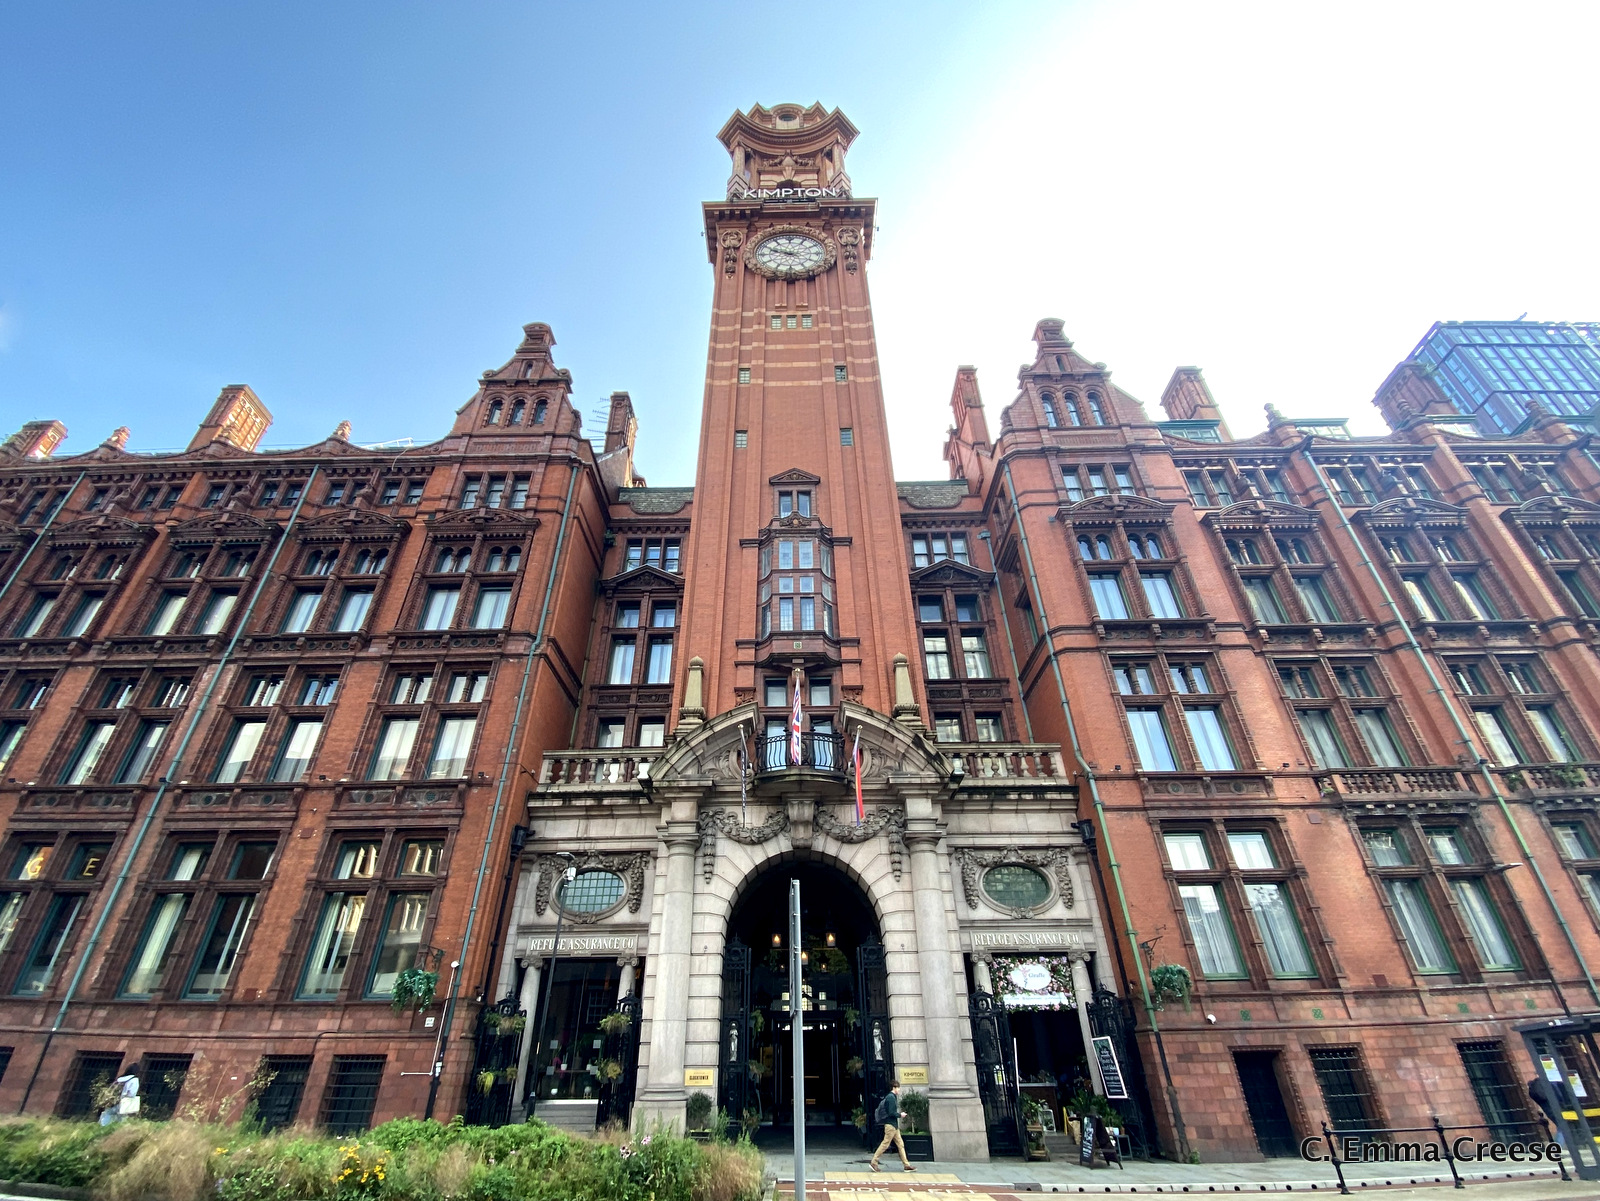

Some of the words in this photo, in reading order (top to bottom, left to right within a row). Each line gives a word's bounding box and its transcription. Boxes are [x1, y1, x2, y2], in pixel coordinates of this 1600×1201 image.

[743, 188, 836, 198] KIMPTON
[567, 938, 619, 950] ASSURANCE
[974, 932, 1010, 945] REFUGE
[1013, 932, 1066, 944] ASSURANCE
